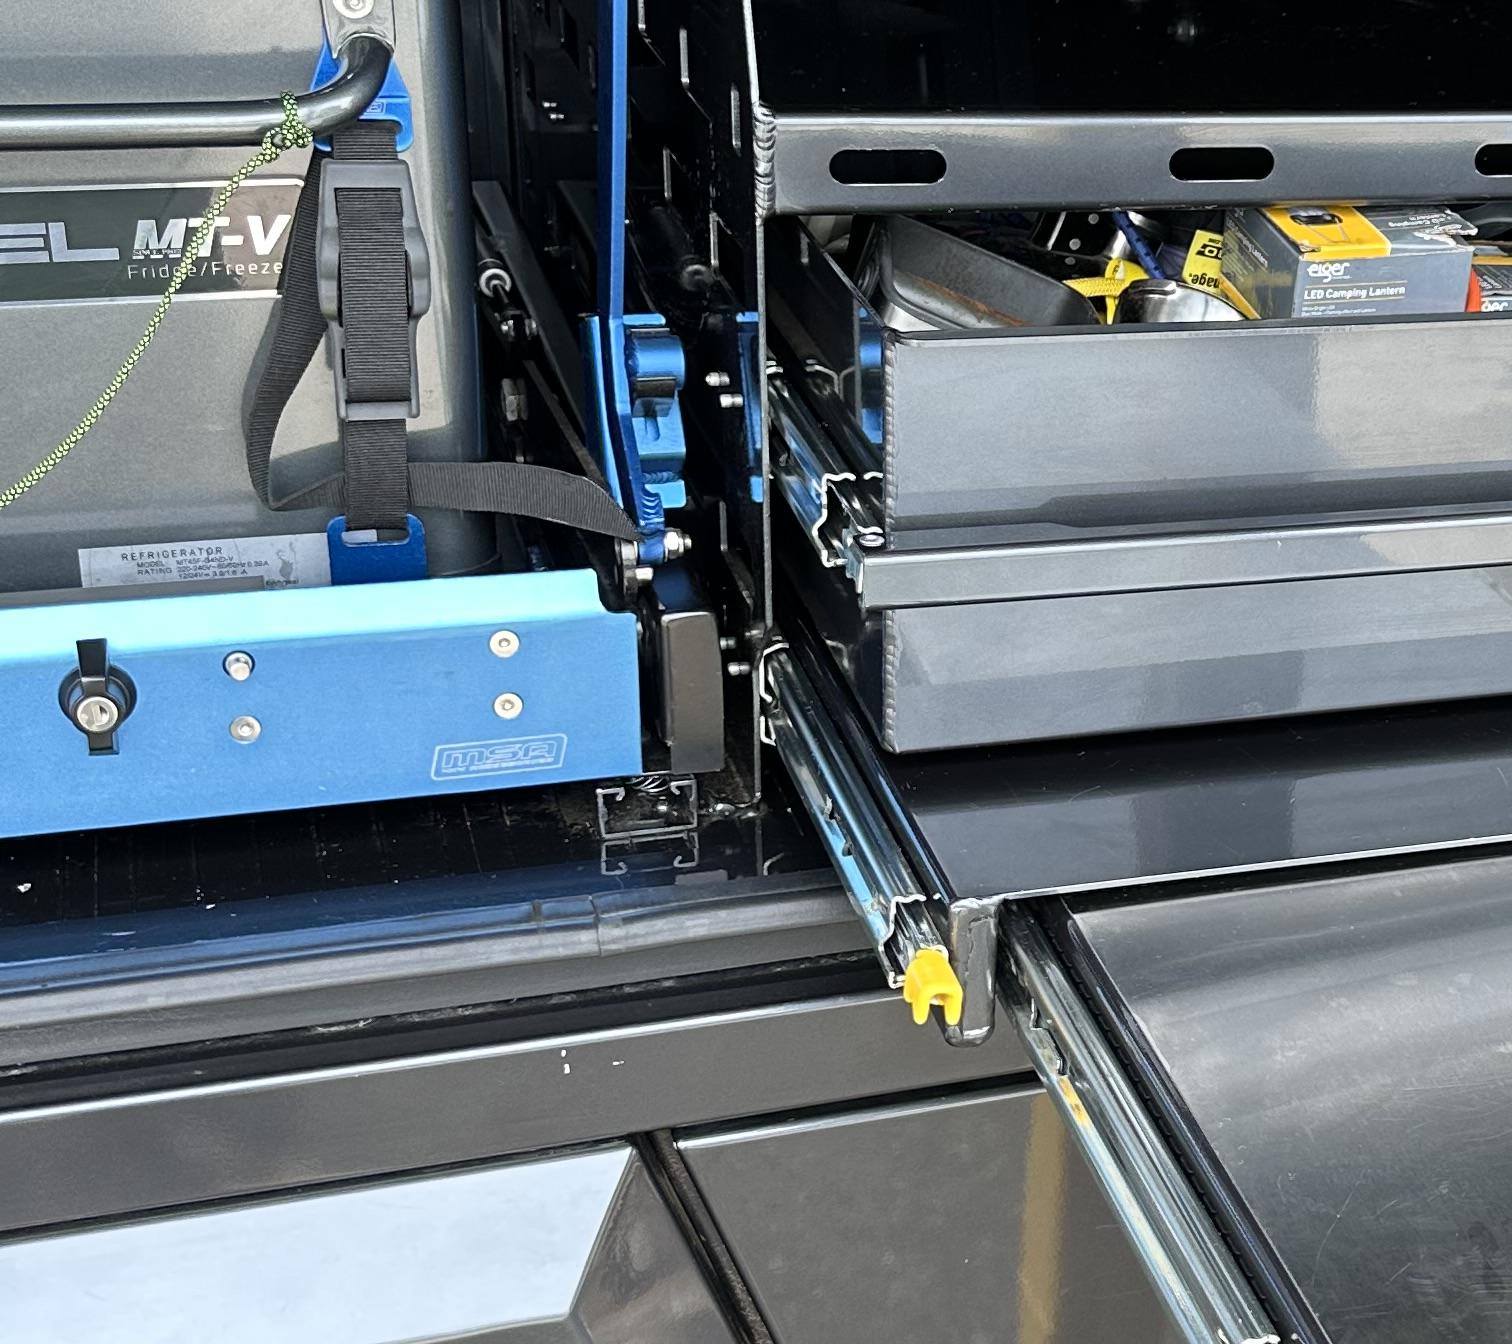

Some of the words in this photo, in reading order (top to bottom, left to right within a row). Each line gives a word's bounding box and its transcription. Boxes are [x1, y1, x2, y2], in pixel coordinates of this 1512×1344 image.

[132, 214, 292, 260] MT-V
[1307, 262, 1350, 283] eiger
[1304, 289, 1324, 300] LED
[1326, 288, 1367, 300] Camping
[1369, 285, 1406, 297] Lantern
[121, 546, 224, 562] REFRIGERATOR
[137, 560, 166, 569] MODEL
[137, 566, 173, 576] RATING
